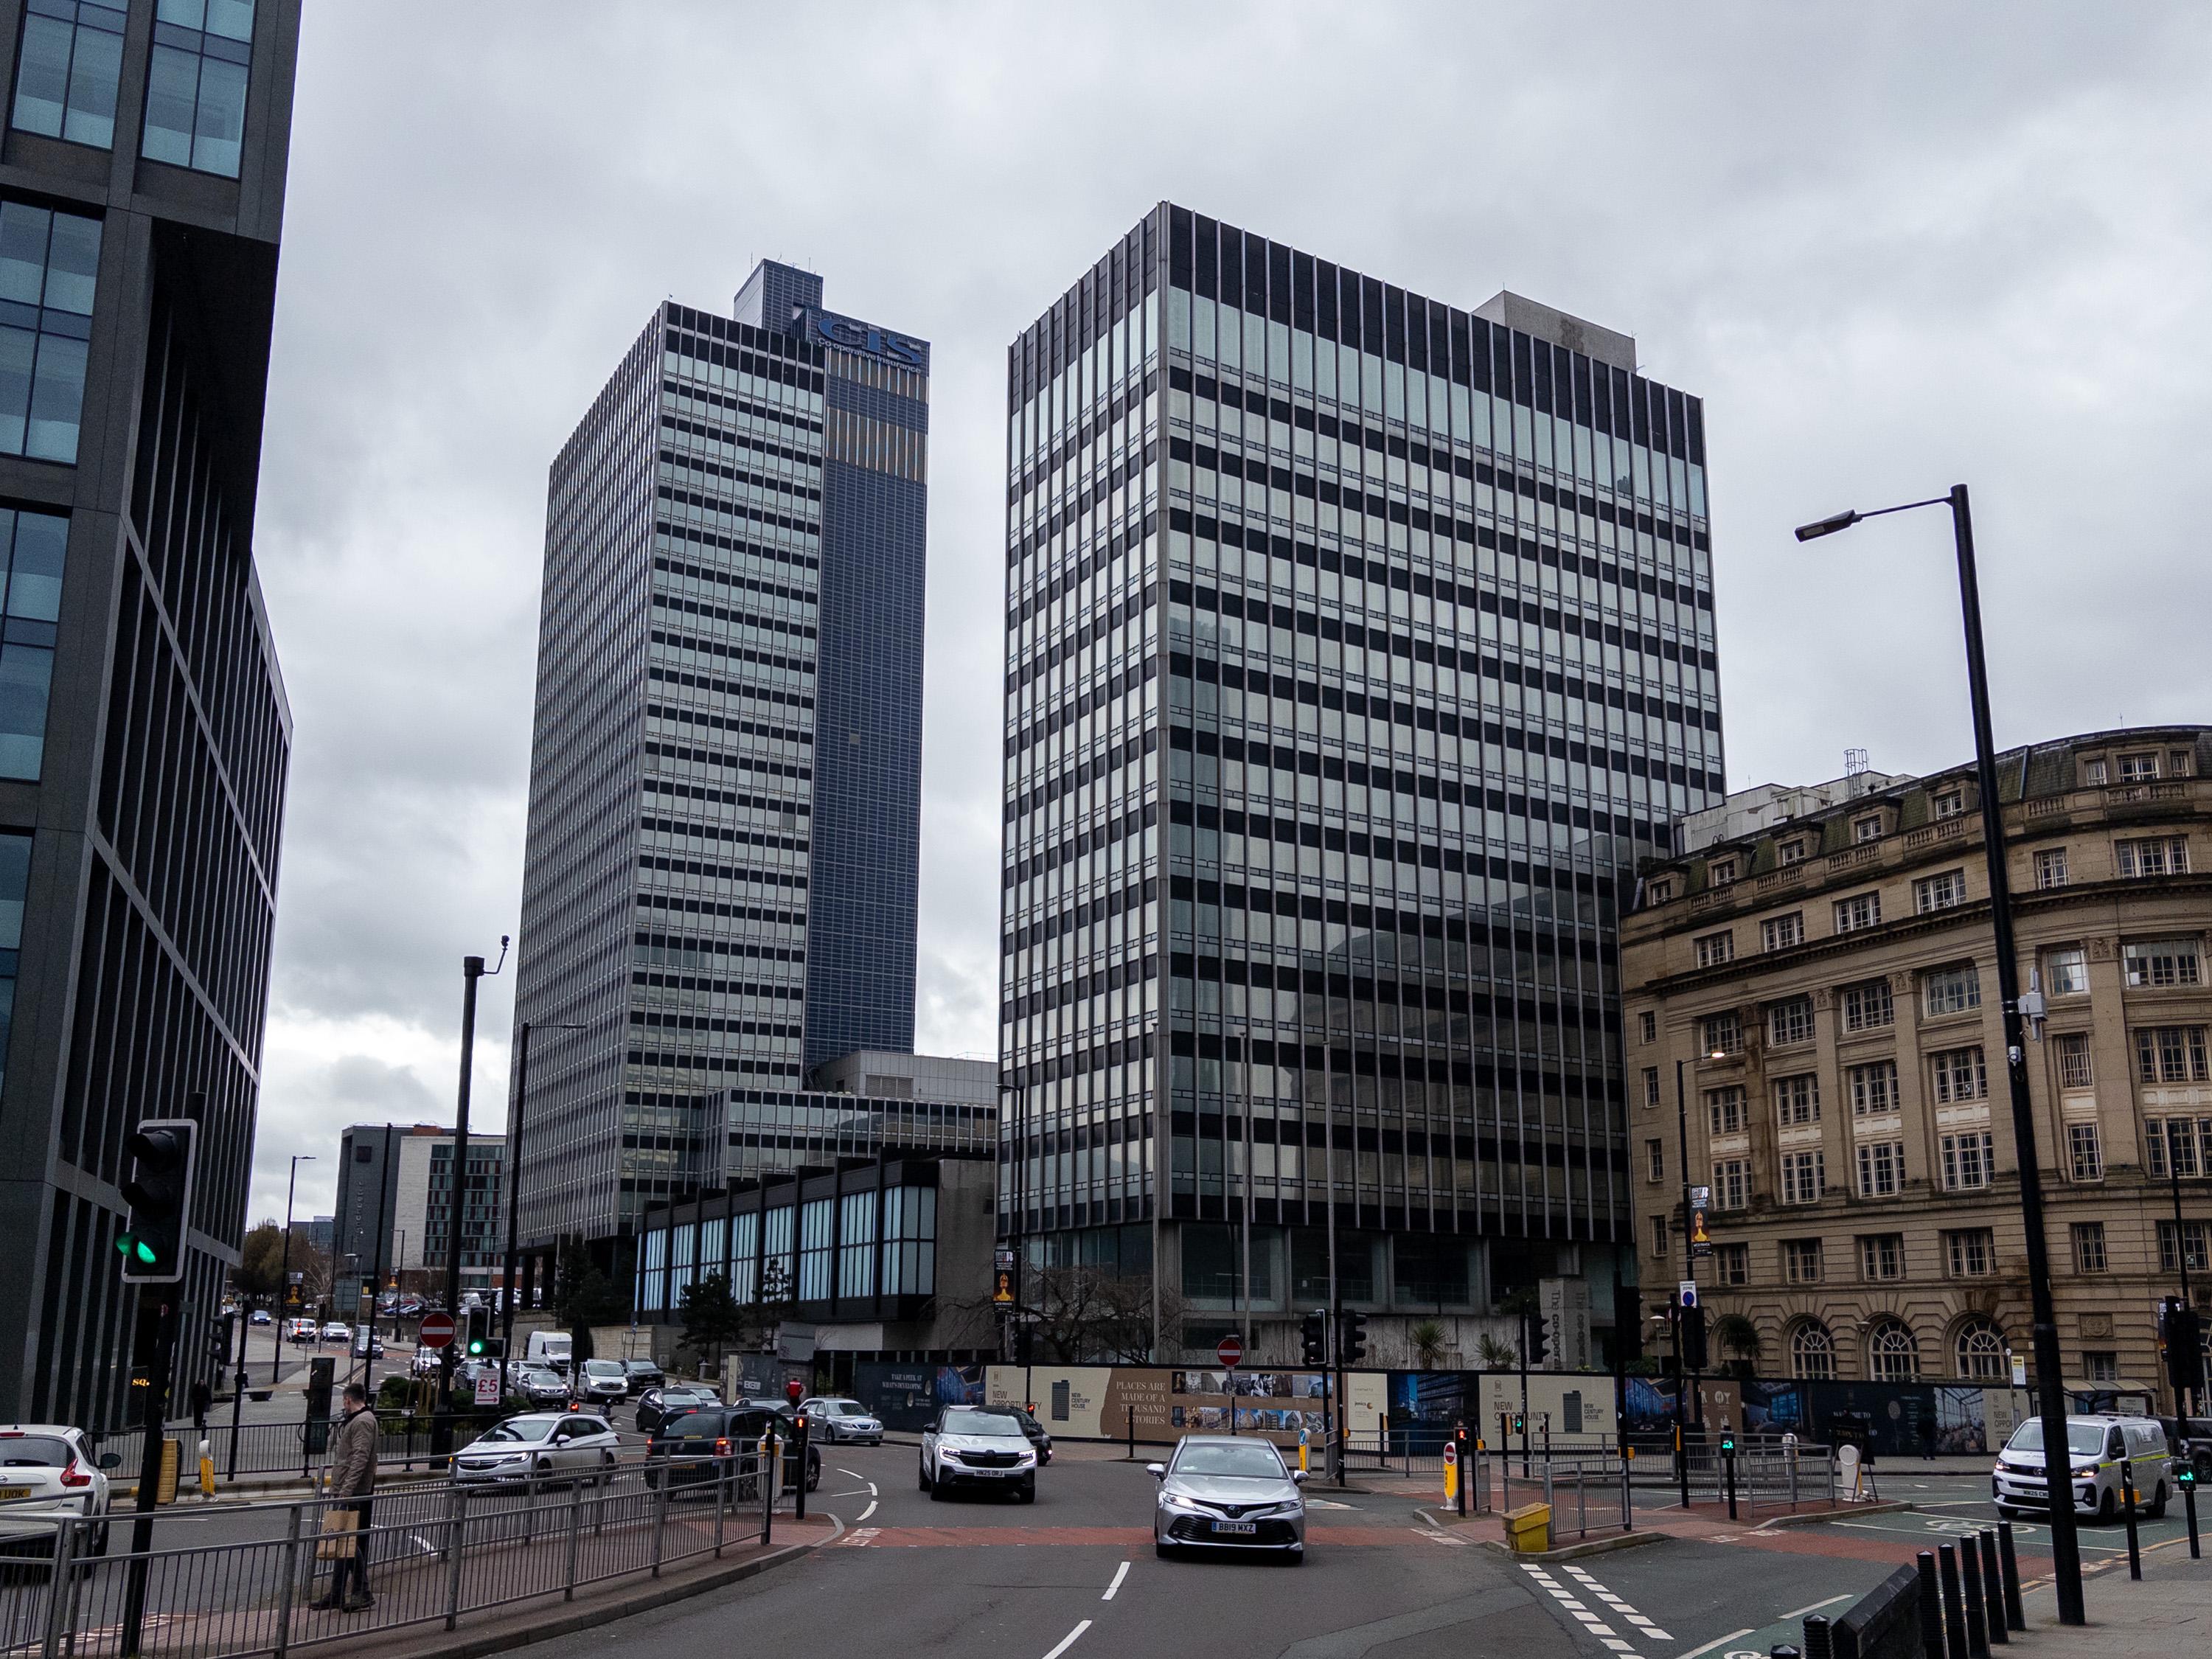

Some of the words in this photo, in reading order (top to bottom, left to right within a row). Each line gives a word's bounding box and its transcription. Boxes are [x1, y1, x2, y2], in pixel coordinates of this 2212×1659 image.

[818, 318, 922, 364] CIS
[877, 355, 922, 374] Insurance
[1551, 1290, 1560, 1310] The
[478, 1379, 498, 1393] £5
[1116, 1381, 1147, 1390] PLACES
[1148, 1382, 1166, 1391] ARE
[1121, 1393, 1144, 1402] MADE
[1146, 1394, 1158, 1402] OF
[1160, 1394, 1166, 1402] A
[1494, 1402, 1512, 1411] NEW
[1994, 1411, 2007, 1419] NEW
[1219, 1523, 1237, 1531] BB19
[1238, 1524, 1254, 1533] MXZ
